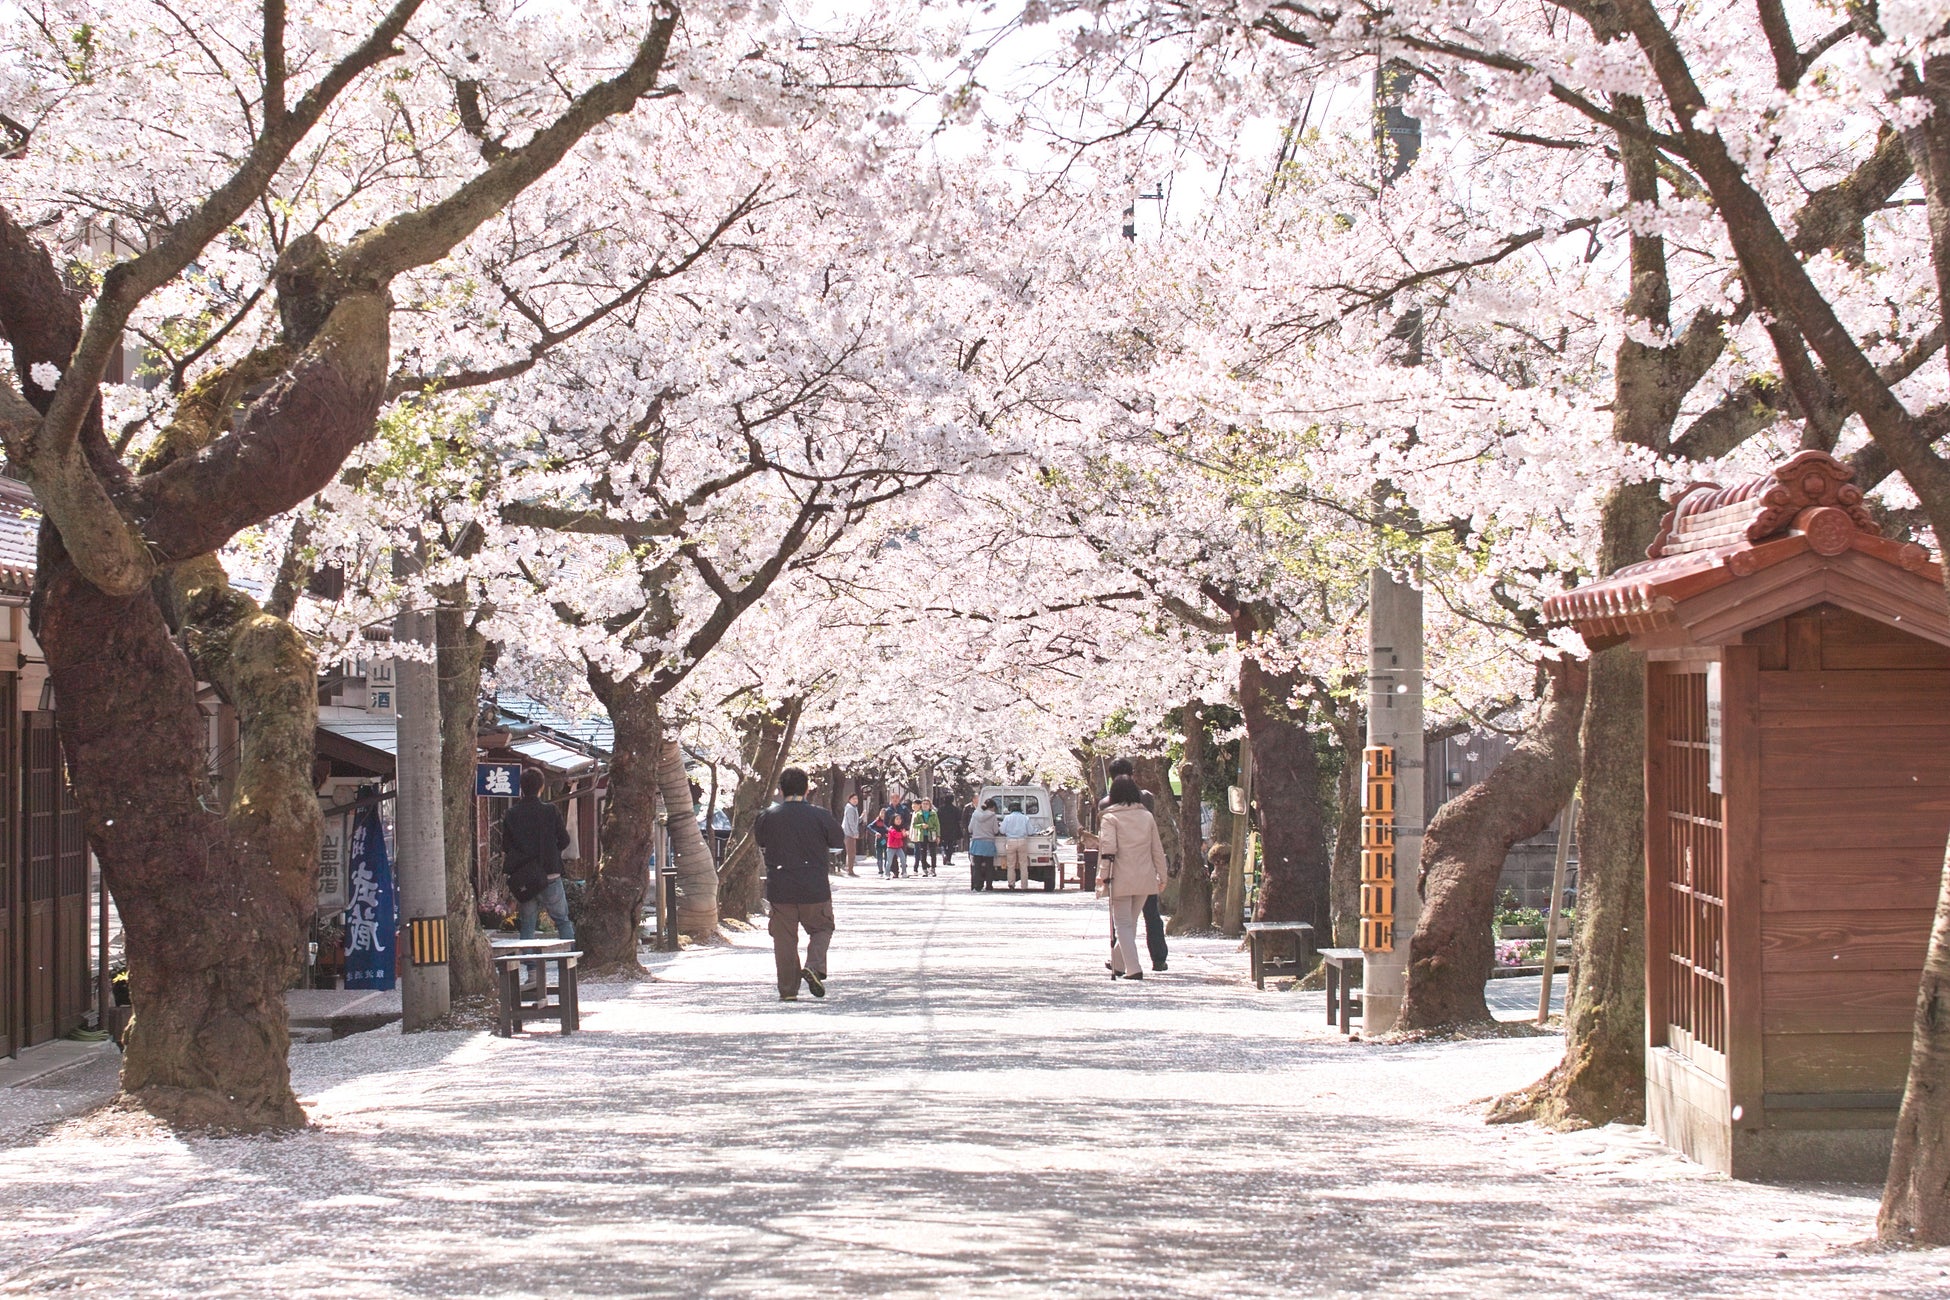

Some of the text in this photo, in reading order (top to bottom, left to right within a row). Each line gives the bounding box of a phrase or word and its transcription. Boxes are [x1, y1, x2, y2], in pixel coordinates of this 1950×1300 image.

[485, 766, 512, 793] 塩
[318, 835, 340, 893] 山田商店
